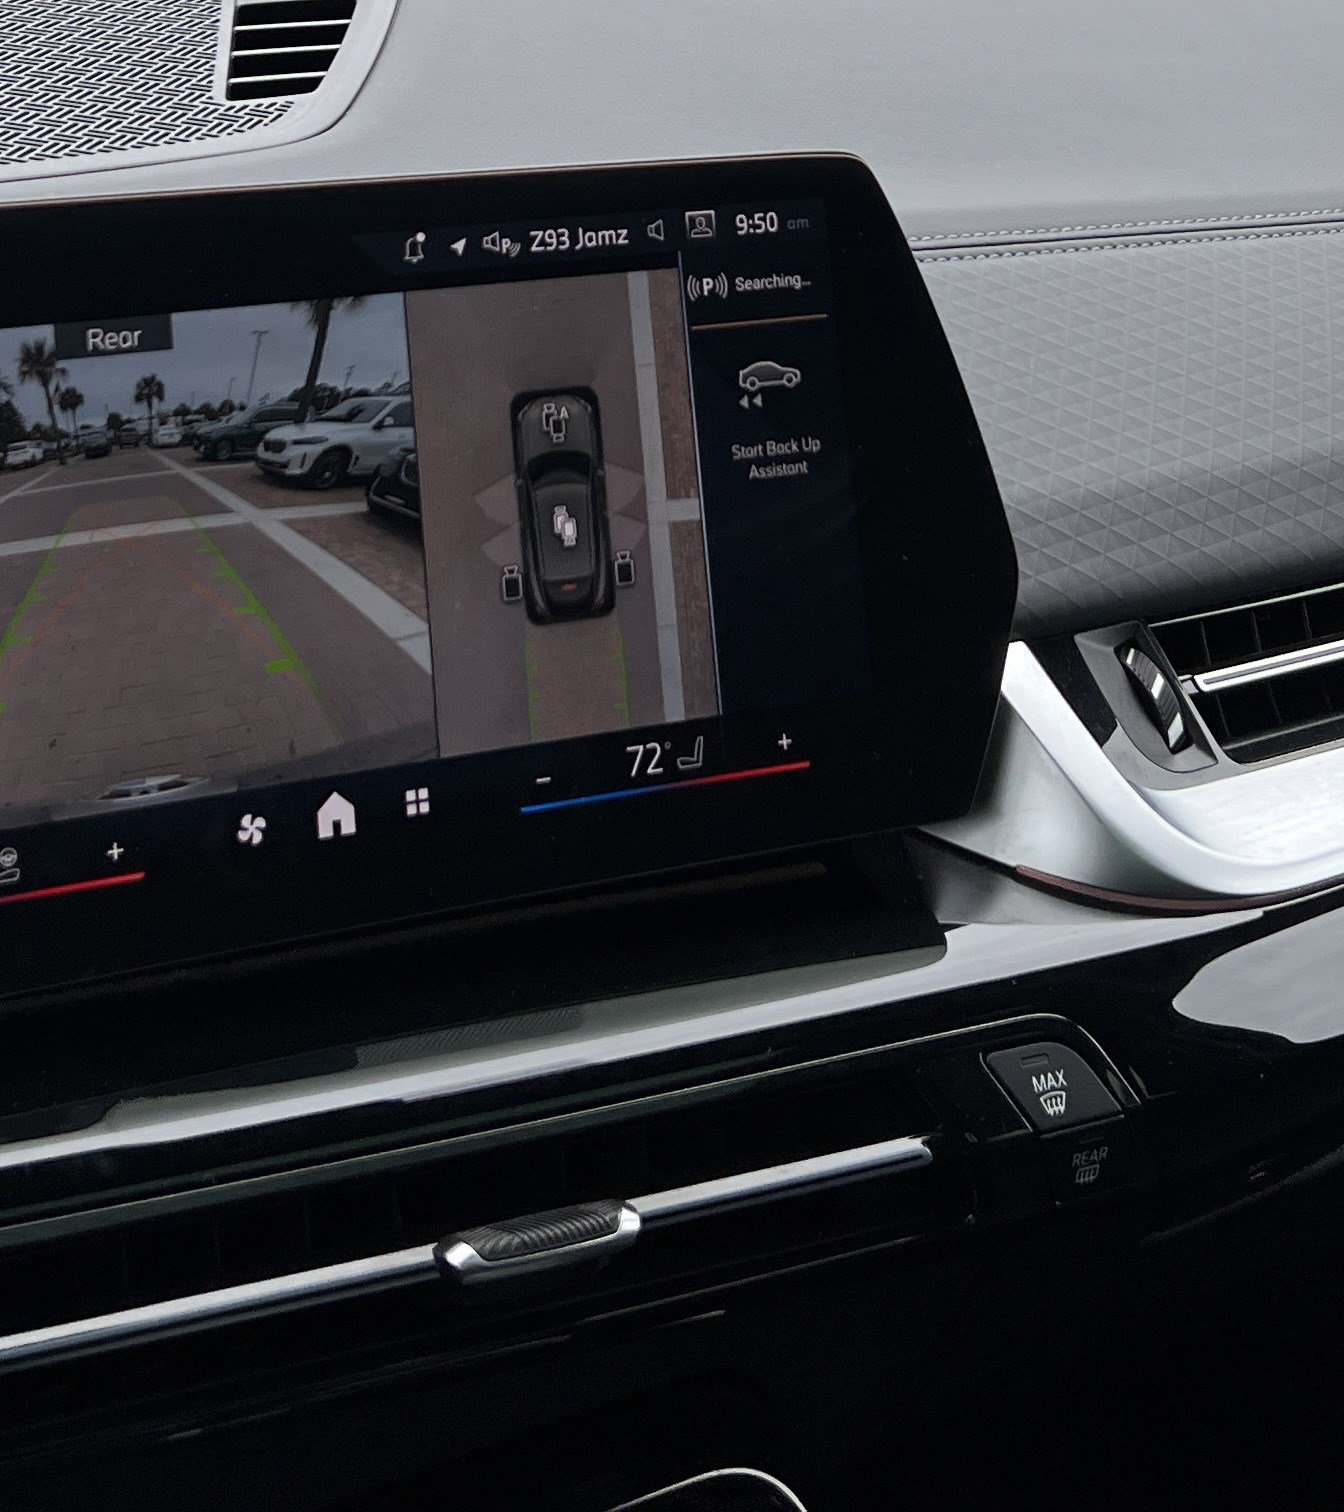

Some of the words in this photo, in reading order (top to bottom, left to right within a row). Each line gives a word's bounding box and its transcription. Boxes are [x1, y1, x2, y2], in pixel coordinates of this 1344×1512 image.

[735, 211, 778, 235] 9:50
[787, 217, 810, 231] am
[529, 228, 570, 252] Z93
[575, 226, 629, 251] Jamz
[85, 327, 143, 353] Rear
[731, 442, 764, 461] Start
[766, 438, 799, 457] Back
[802, 435, 821, 453] Up
[748, 460, 809, 481] Assistant
[1032, 1068, 1068, 1093] MAX
[1072, 1146, 1109, 1167] REAR
